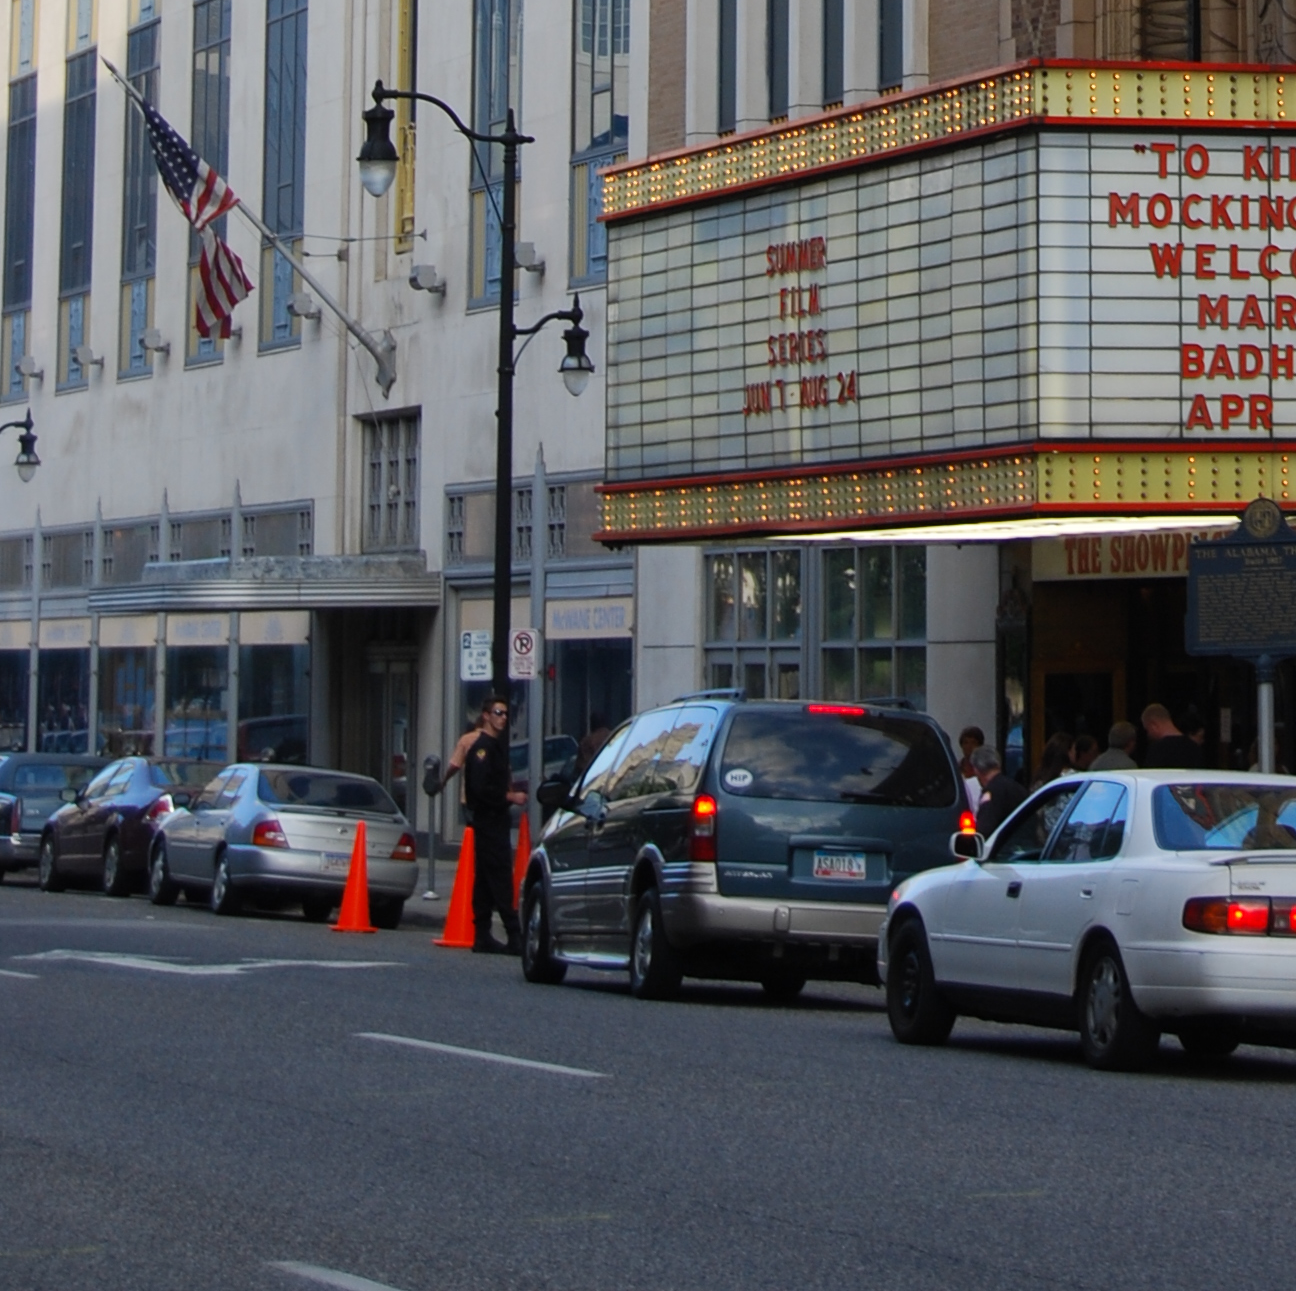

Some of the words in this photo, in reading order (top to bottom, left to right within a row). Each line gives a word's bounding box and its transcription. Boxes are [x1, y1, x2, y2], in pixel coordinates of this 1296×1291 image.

[1133, 142, 1210, 179] "TO
[766, 236, 827, 278] SUMMER
[779, 283, 821, 320] FILM
[767, 328, 827, 368] SERIES
[743, 380, 771, 416] JUN
[801, 374, 829, 409] AUG
[836, 370, 858, 406] 24
[1186, 394, 1274, 431] APR
[1064, 536, 1101, 575] THE
[1195, 549, 1218, 560] THE
[1224, 547, 1277, 558] ALABAMA
[729, 773, 748, 783] HIP
